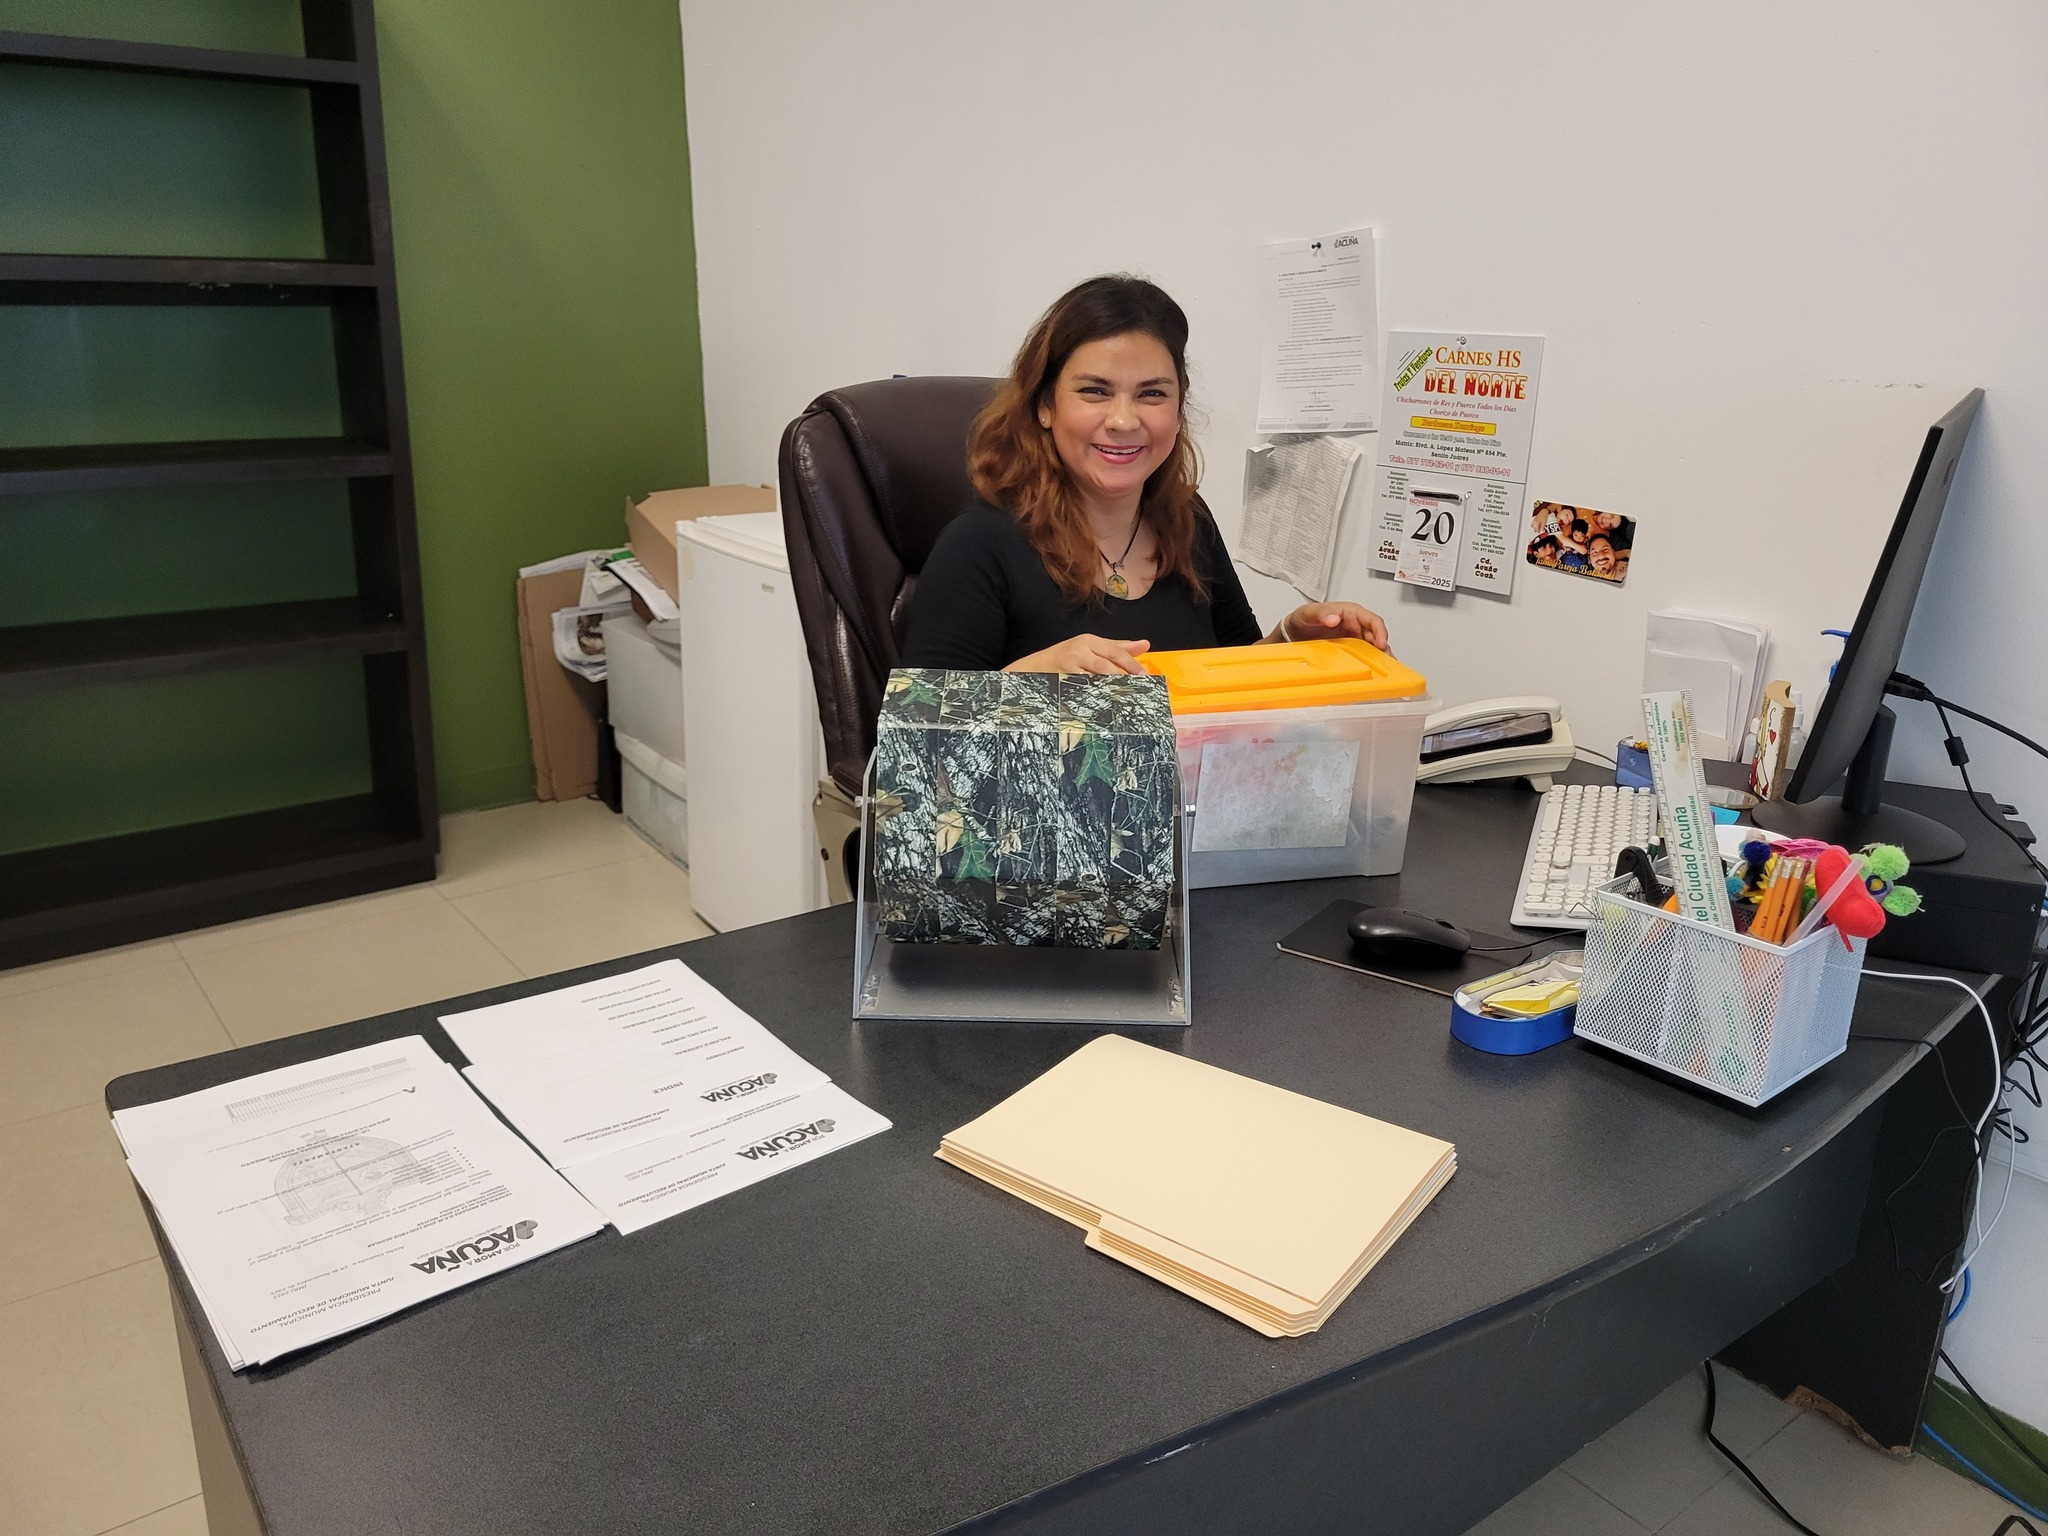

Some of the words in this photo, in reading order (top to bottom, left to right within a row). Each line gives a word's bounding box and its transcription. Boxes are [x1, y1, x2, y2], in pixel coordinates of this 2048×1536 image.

[1411, 347, 1433, 373] Verduras
[1497, 350, 1521, 368] HS
[1424, 369, 1457, 394] DEL
[1464, 372, 1528, 400] NORTE
[1397, 396, 1432, 406] Chicharrones
[1456, 401, 1476, 409] Puerco
[1477, 402, 1492, 410] Todos
[1430, 408, 1450, 416] Chorizo
[1459, 410, 1479, 419] Puerco
[1389, 455, 1405, 463] Tels.
[1455, 464, 1460, 472] y
[1410, 499, 1439, 507] NOVIEMBRE
[1411, 508, 1455, 544] 20
[1379, 546, 1399, 555] Acuña
[1379, 553, 1398, 561] Coah.
[1475, 564, 1498, 573] Acuña
[1475, 571, 1495, 580] Coah.
[1431, 577, 1450, 587] 2025
[1654, 702, 1663, 735] Acreditadas
[1674, 806, 1694, 850] Acuña
[1681, 854, 1704, 901] Ciudad
[1702, 863, 1711, 879] para
[1711, 912, 1718, 921] de
[651, 1024, 680, 1034] GENERAL
[661, 1036, 686, 1046] SORTEO
[674, 1045, 703, 1056] GENERAL
[706, 1045, 744, 1061] DIRECTORIO
[651, 1081, 683, 1094] INDICE
[700, 1075, 764, 1103] ACUÑA
[740, 1088, 758, 1097] AMOR
[652, 1108, 670, 1116] JUNTA
[621, 1114, 651, 1126] MUNICIPAL
[622, 1116, 662, 1131] PRESIDENCIA
[563, 1125, 611, 1143] RECLUTAMIENTO
[585, 1128, 621, 1141] MUNICIPAL
[735, 1123, 819, 1160] ACUÑA
[789, 1140, 811, 1150] AMOR
[708, 1163, 726, 1172] JUNTA
[676, 1171, 707, 1185] MUNICIPAL
[678, 1172, 718, 1190] PRESIDENCIA
[618, 1187, 666, 1207] RECLUTAMIENTO
[640, 1188, 677, 1204] MUNICIPAL
[409, 1226, 515, 1275] ACUÑA
[503, 1242, 520, 1252] POR
[473, 1250, 502, 1263] AMOR
[371, 1277, 394, 1287] JUNTA
[328, 1285, 369, 1302] MUNICIPAL
[328, 1288, 381, 1310] PRESIDENCIA
[250, 1306, 315, 1333] RECLUTAMIENTO
[278, 1307, 326, 1328] MUNICIPAL
